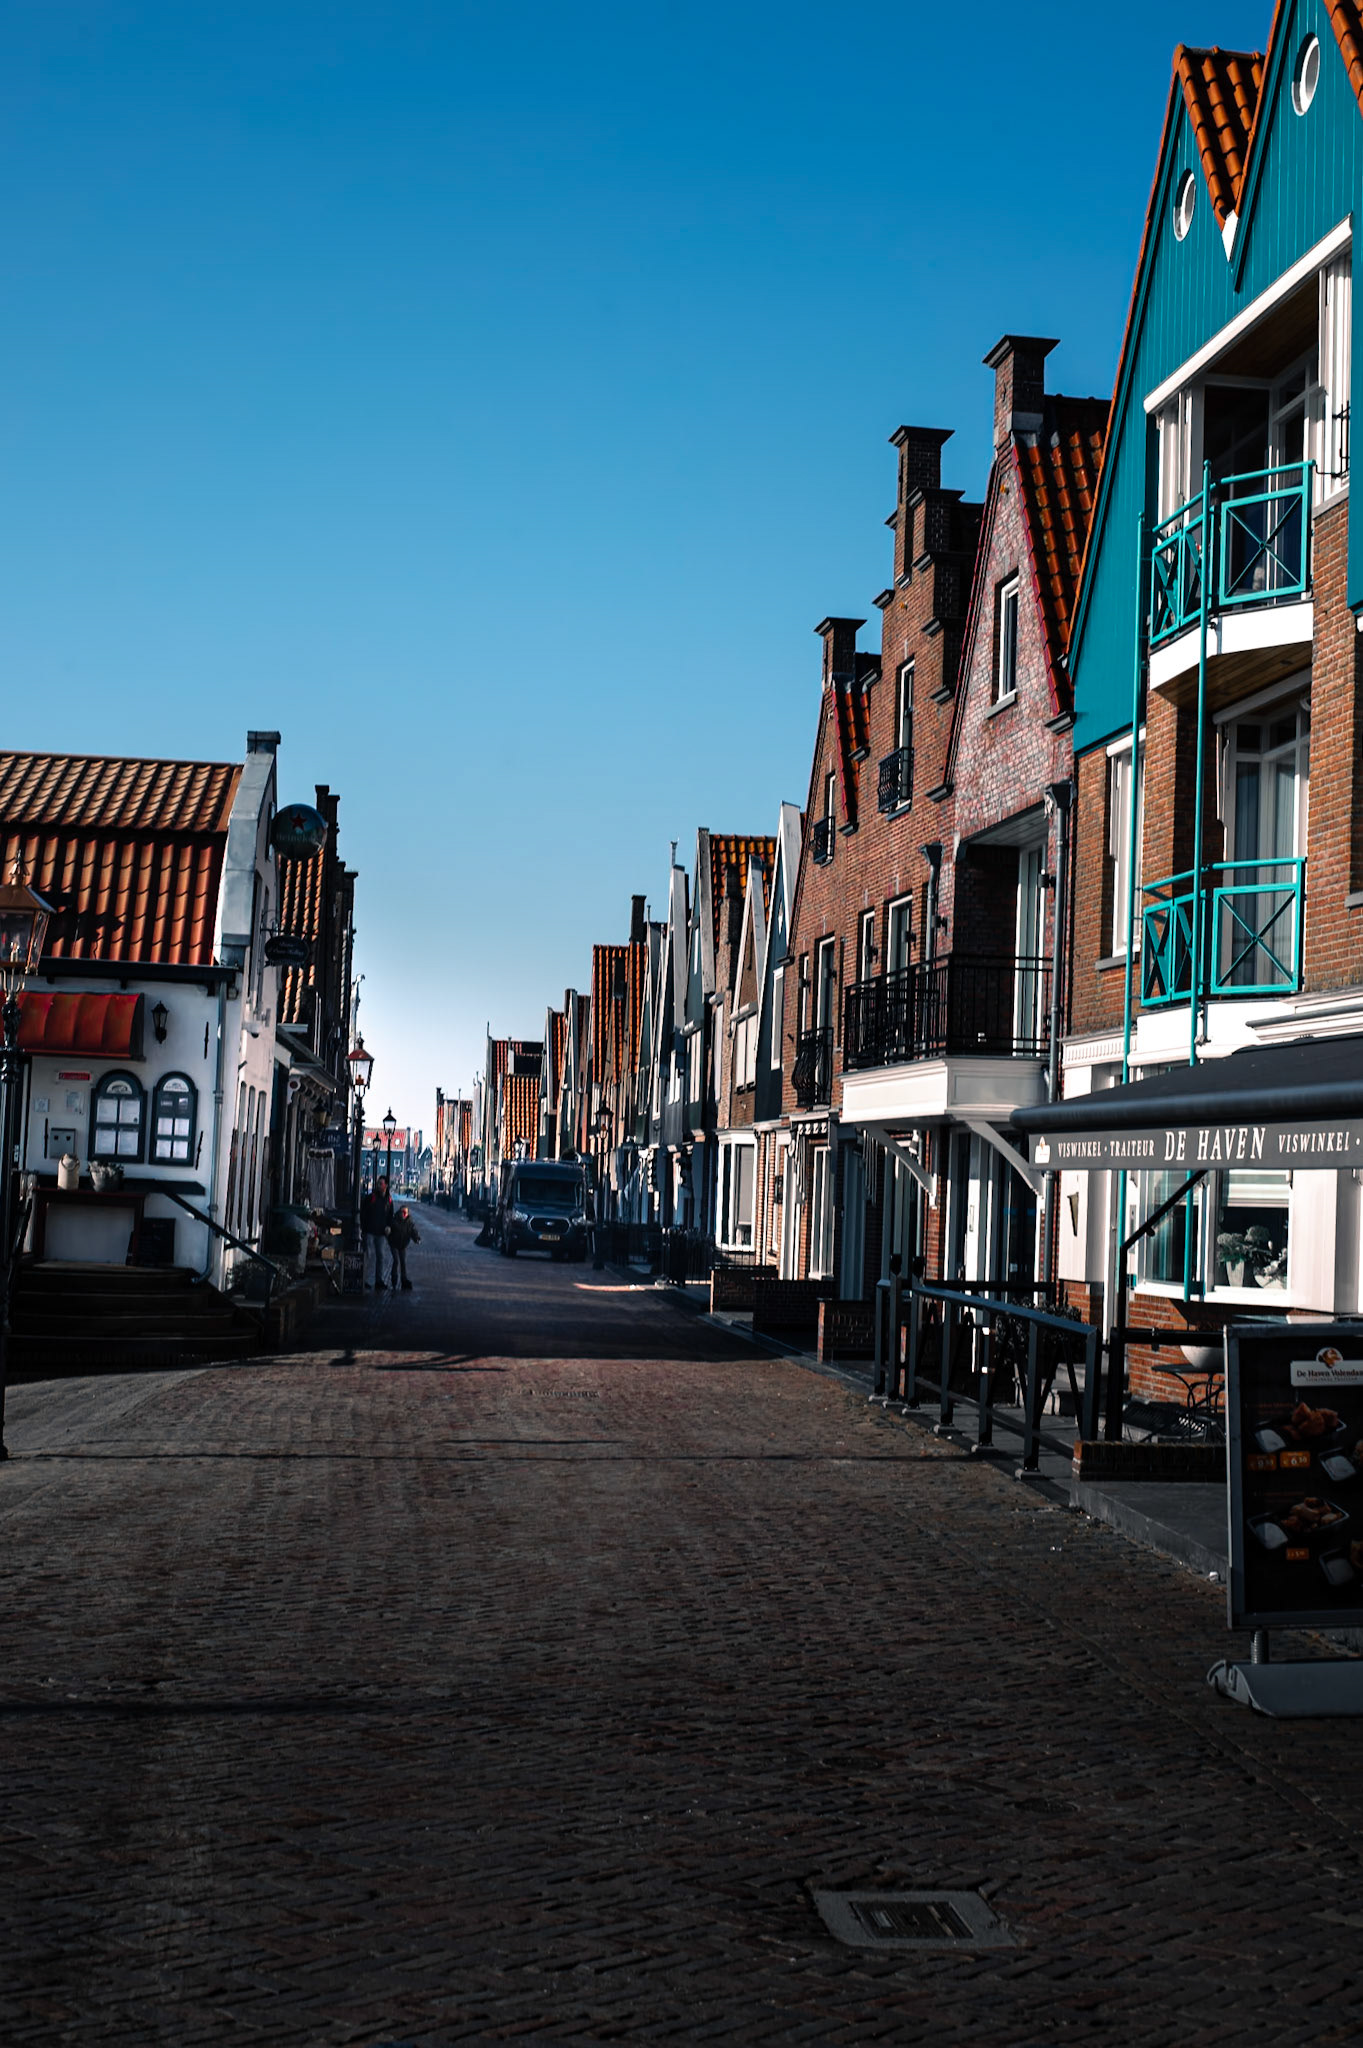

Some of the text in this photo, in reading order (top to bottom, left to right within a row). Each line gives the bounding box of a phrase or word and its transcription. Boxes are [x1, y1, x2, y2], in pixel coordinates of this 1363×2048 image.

[1058, 1127, 1350, 1161] VISWINKEL TRAITEUR DE HAVEN VISWINKEL
[1296, 1369, 1306, 1377] De
[1308, 1369, 1330, 1377] Haven
